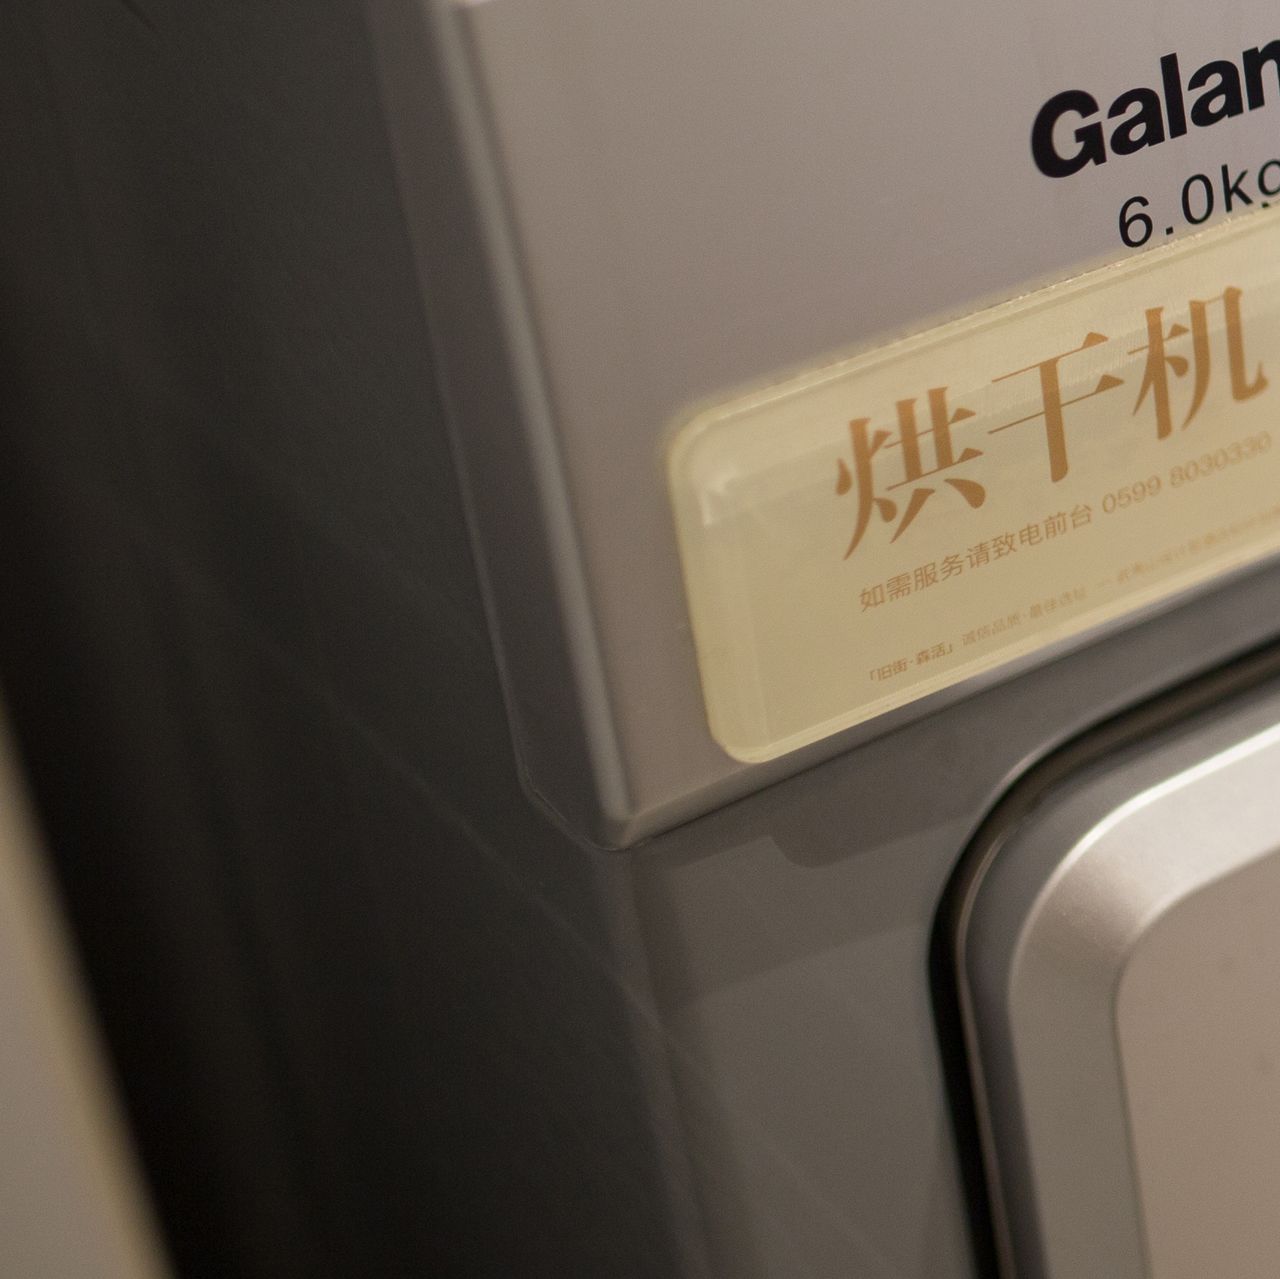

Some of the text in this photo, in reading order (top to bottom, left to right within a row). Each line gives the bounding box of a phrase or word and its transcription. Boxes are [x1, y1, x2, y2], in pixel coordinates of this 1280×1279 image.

[835, 286, 1268, 560] 烘干机
[859, 504, 1093, 612] 如需服务请致电前台
[1102, 475, 1161, 514] 0599
[1169, 430, 1272, 488] 8030330
